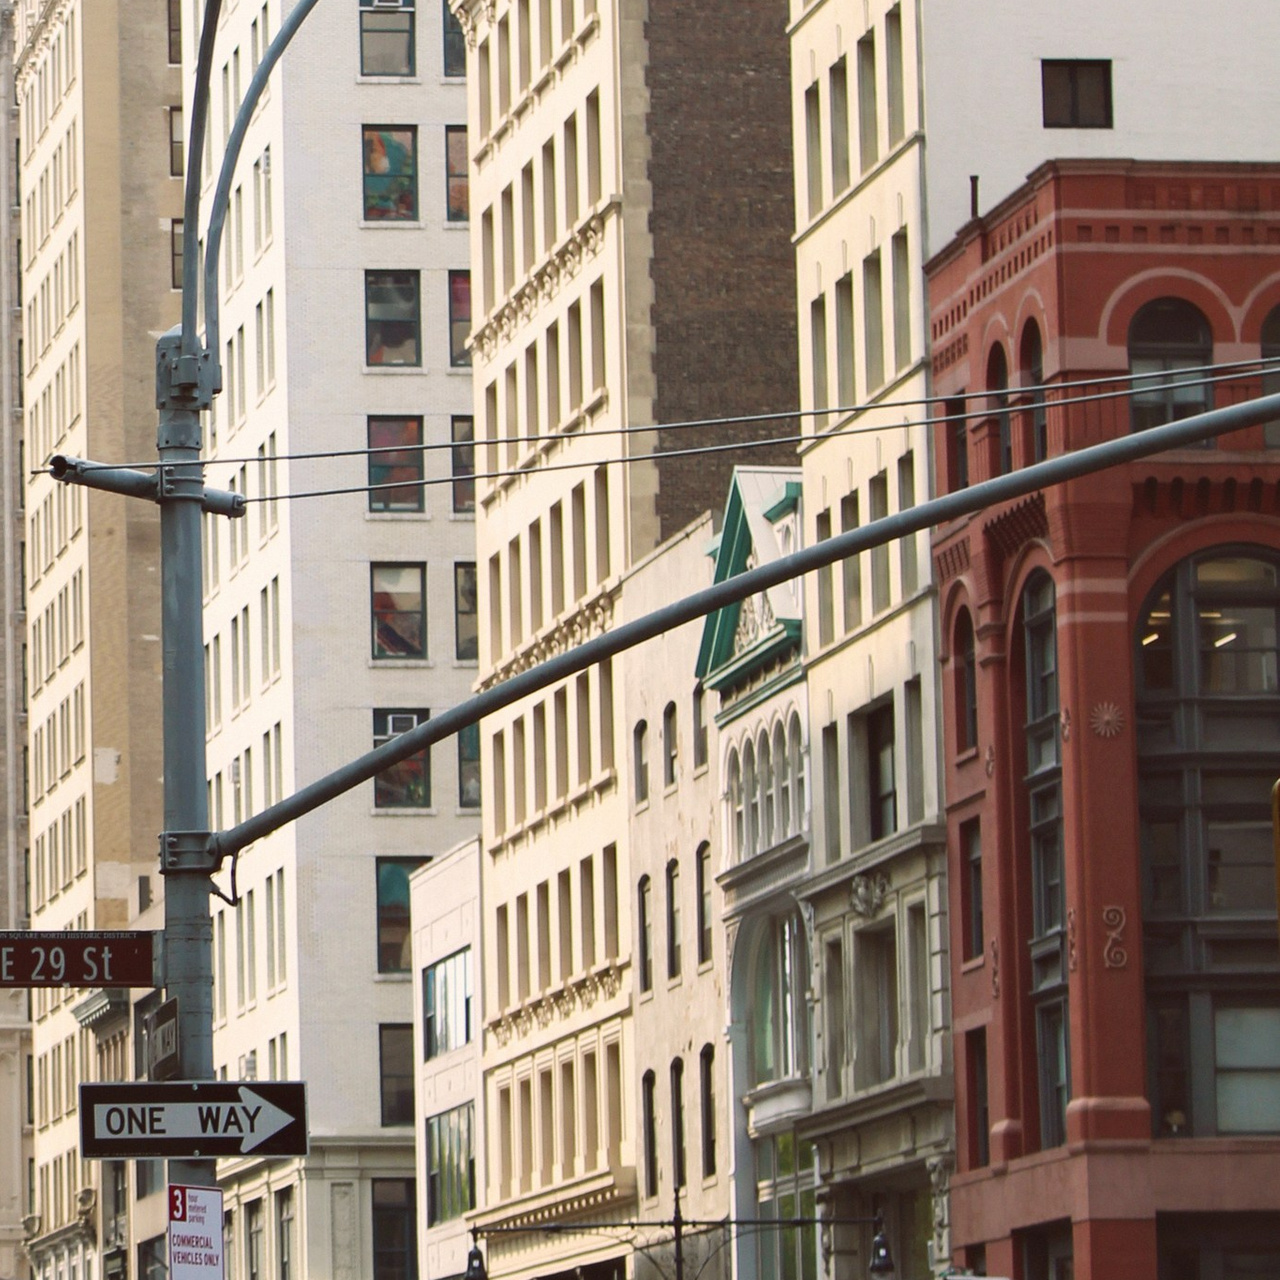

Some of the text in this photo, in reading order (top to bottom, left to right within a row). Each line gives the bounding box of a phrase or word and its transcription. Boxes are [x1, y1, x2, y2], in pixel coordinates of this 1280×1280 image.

[103, 931, 138, 939] DISTRICT
[1, 946, 113, 981] E 29 St
[105, 1106, 263, 1135] ONE WAY
[173, 1189, 183, 1219] 3
[172, 1234, 213, 1249] COMMERCIAL
[173, 1251, 220, 1266] VEHICLES ONLY
